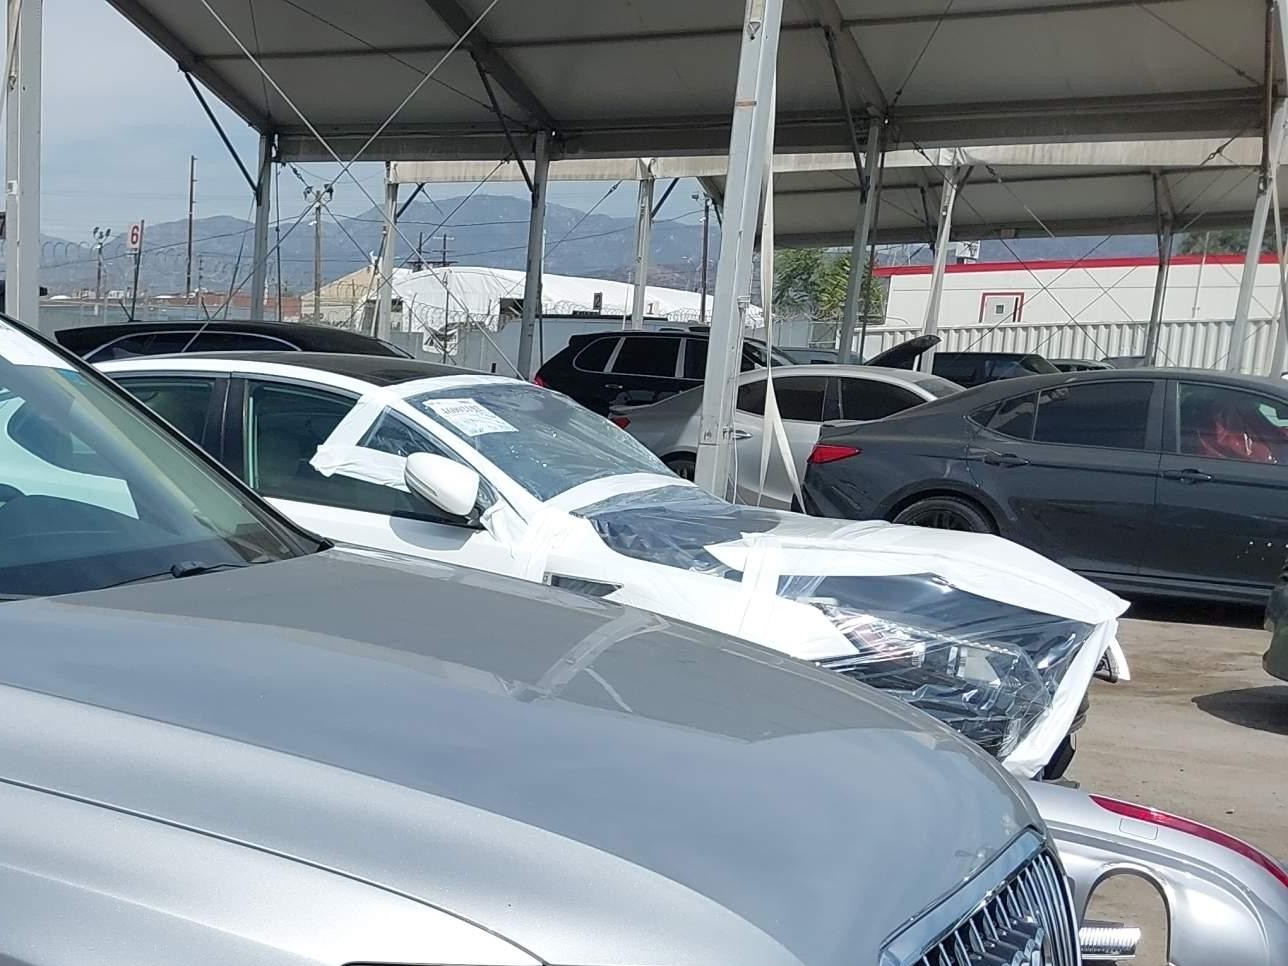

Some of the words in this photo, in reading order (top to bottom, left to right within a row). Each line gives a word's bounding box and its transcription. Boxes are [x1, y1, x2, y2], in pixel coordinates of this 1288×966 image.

[130, 225, 140, 245] 6
[595, 295, 601, 308] 2
[646, 303, 655, 315] 1
